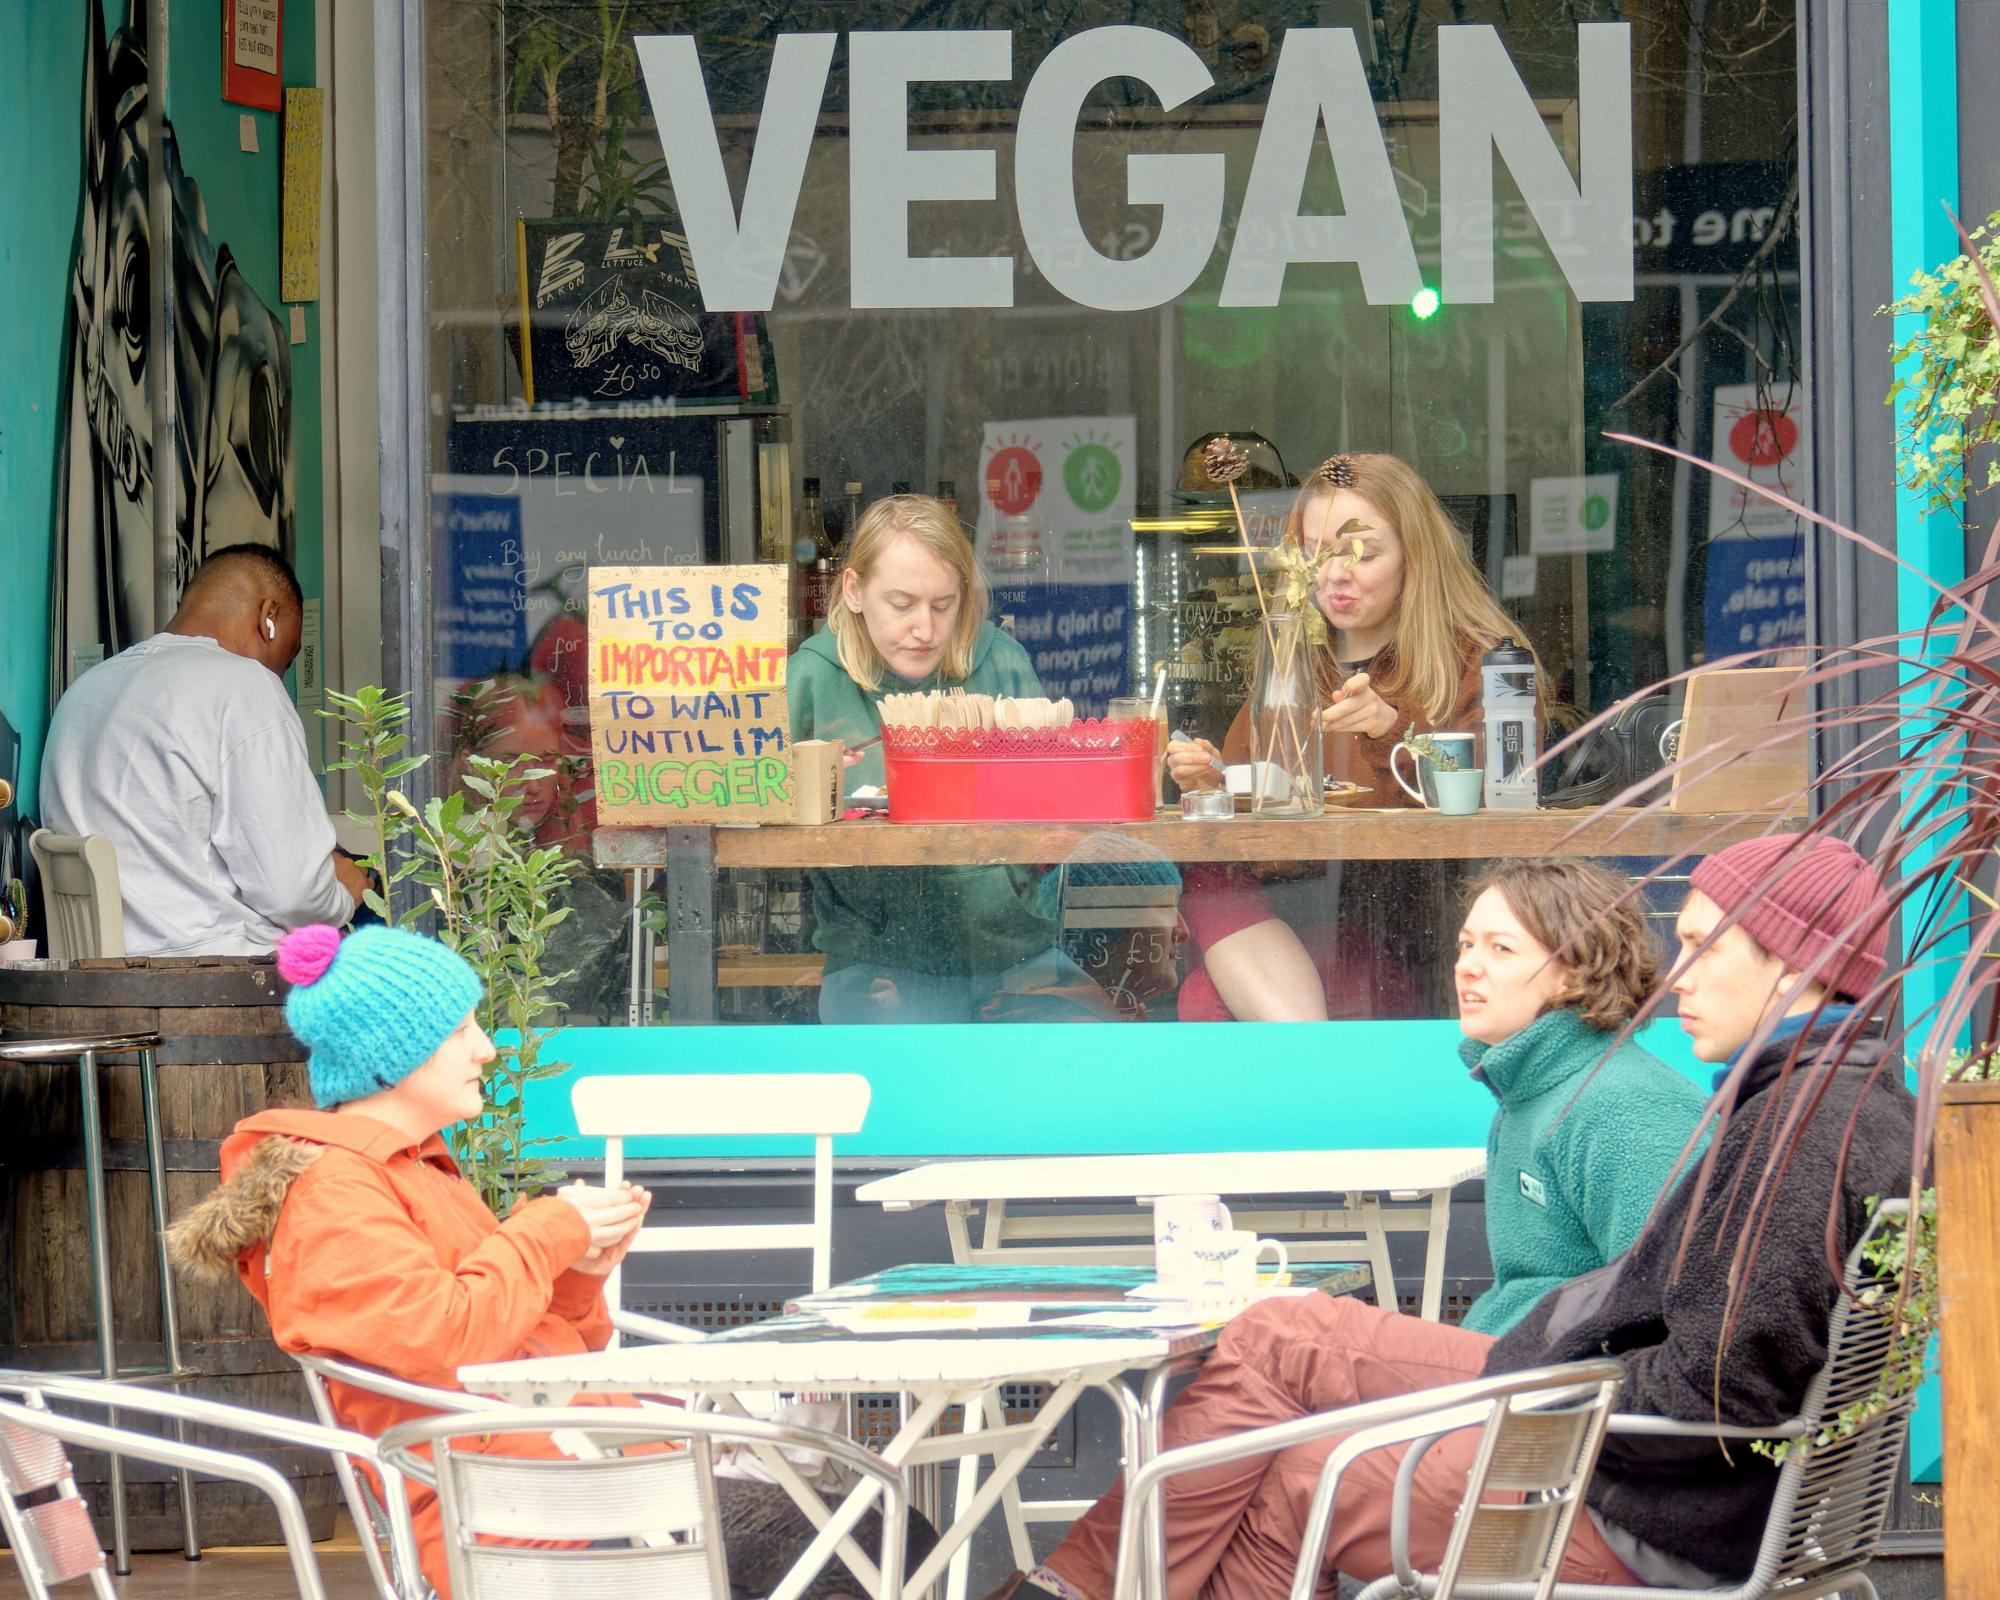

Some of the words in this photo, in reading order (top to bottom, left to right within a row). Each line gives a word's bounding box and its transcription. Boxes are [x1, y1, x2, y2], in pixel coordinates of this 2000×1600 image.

[634, 22, 1634, 312] VEGAN
[537, 274, 585, 310] BAKON
[483, 446, 694, 497] SPECIAL
[501, 539, 541, 586] Buy
[555, 547, 588, 583] any
[596, 532, 654, 562] lunch
[511, 585, 551, 613] item
[593, 582, 691, 620] THIS
[711, 582, 762, 621] IS
[1176, 602, 1232, 625] LOAVES
[648, 619, 724, 641] TOO
[551, 636, 583, 673] for
[600, 641, 788, 689] IMPORTANT
[601, 690, 655, 720] TO
[671, 691, 771, 721] WAIT
[605, 728, 724, 755] UNTIL
[599, 756, 790, 809] BIGGER
